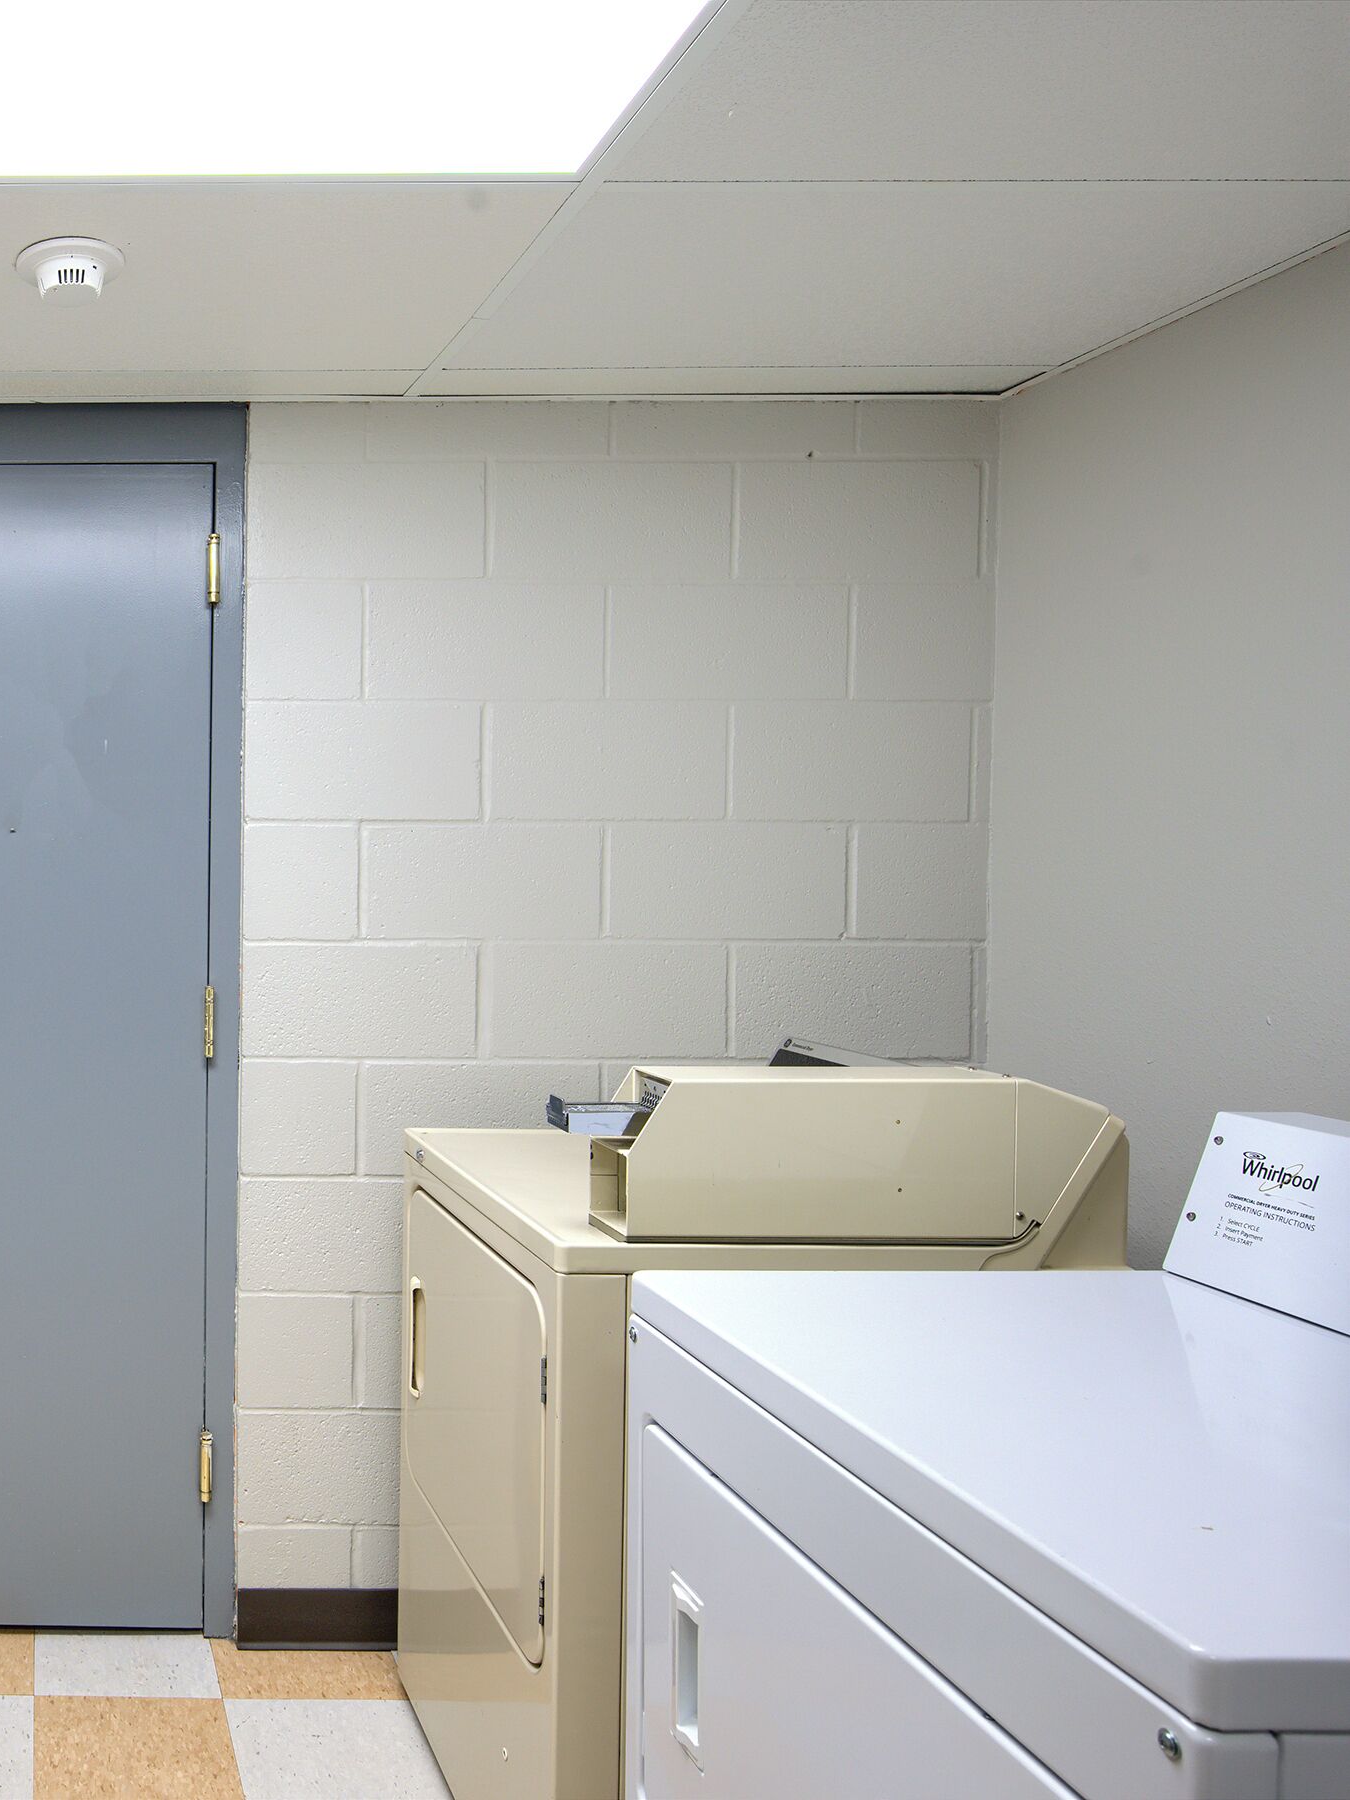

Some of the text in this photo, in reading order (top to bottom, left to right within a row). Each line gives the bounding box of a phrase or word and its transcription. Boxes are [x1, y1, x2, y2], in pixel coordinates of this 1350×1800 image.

[1242, 1158, 1320, 1192] Whirlpool
[1224, 1201, 1316, 1232] OPERATING INSTRUCTIONS
[1227, 1193, 1316, 1221] COMMERCIAL DRYER HEAVY DUTY SERIES
[1224, 1225, 1240, 1236] Insert
[1240, 1230, 1264, 1242] Payment
[1227, 1218, 1243, 1229] Select
[1243, 1222, 1260, 1233] CYCLE
[1222, 1233, 1236, 1243] Press
[1236, 1237, 1253, 1247] START
